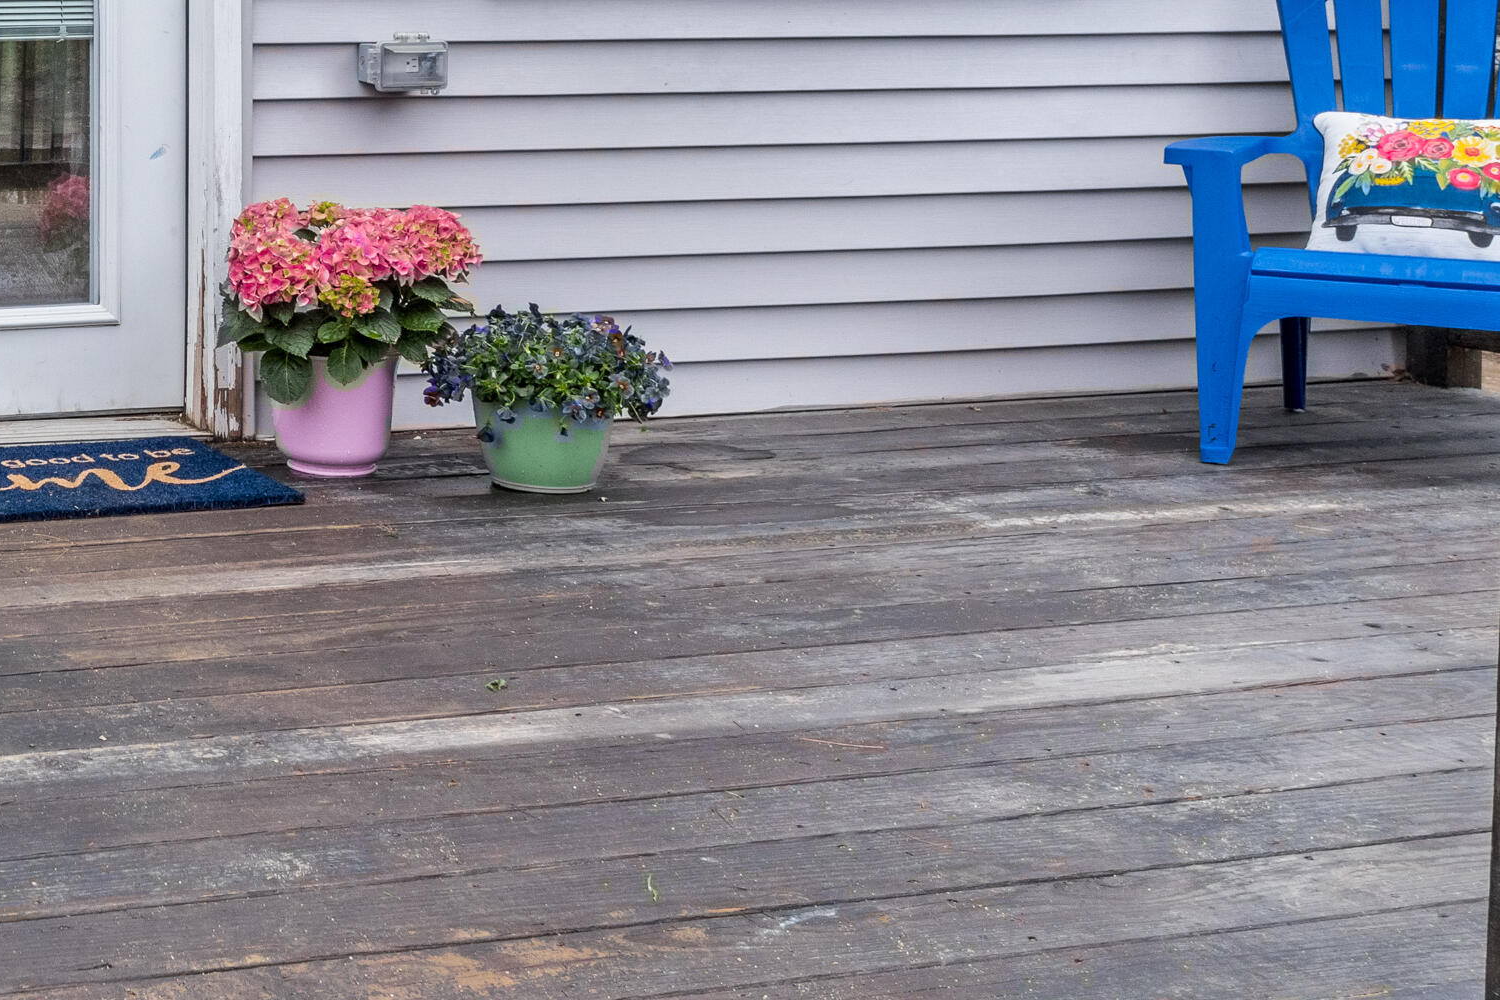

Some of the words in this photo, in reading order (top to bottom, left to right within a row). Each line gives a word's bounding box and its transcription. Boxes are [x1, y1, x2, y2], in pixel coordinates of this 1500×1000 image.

[0, 453, 95, 469] good
[100, 453, 139, 461] to
[143, 447, 196, 459] be
